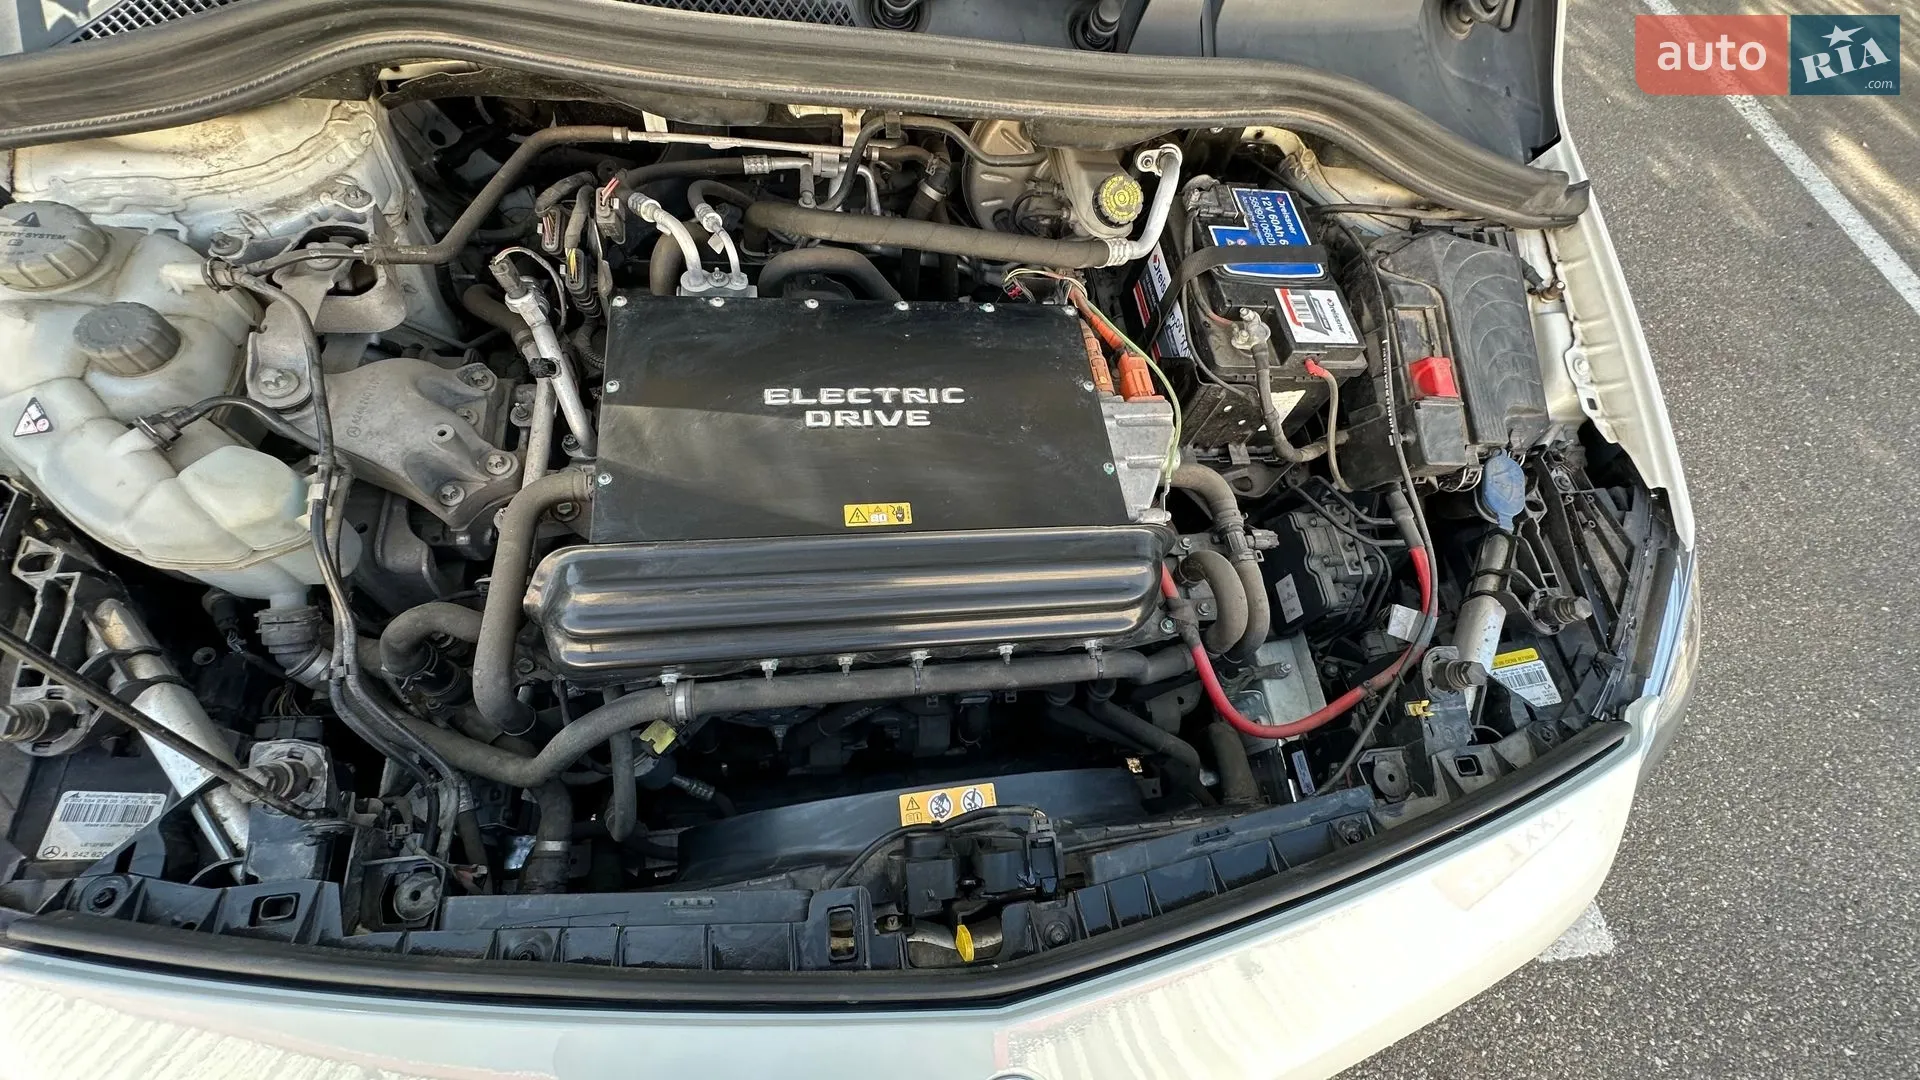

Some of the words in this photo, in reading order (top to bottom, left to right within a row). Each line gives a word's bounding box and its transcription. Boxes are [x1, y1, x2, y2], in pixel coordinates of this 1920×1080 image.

[1260, 196, 1275, 213] 12V
[1268, 213, 1285, 238] 60Ah
[25, 232, 66, 240] SYSTEM
[764, 387, 965, 405] ELECTRIC
[805, 410, 931, 427] DRIVE
